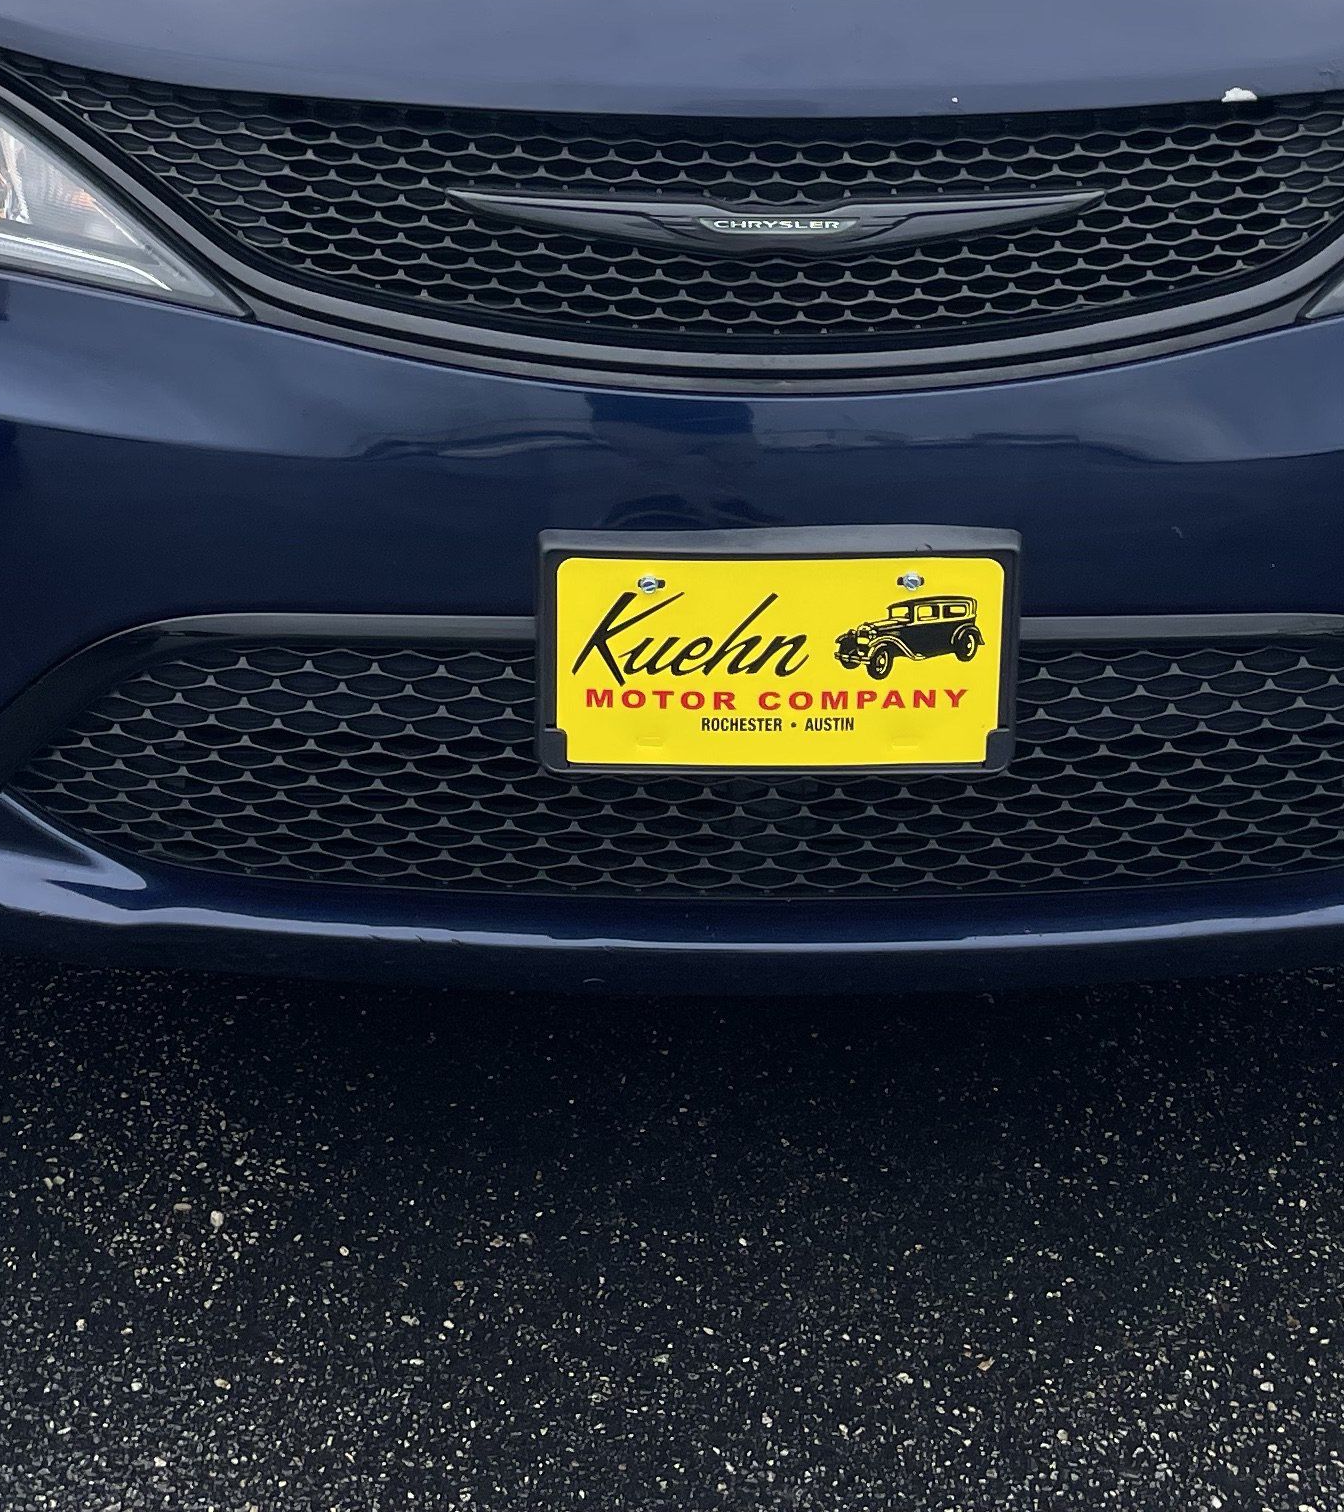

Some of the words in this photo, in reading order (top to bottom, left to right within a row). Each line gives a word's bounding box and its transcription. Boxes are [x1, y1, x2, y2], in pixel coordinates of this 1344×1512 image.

[713, 219, 841, 230] CHRYSLER
[571, 591, 810, 686] Kuehn
[585, 689, 736, 710] MOTOR
[758, 689, 969, 710] COMPANY
[701, 717, 783, 732] ROCHESTER
[804, 717, 855, 732] AUSTIN
